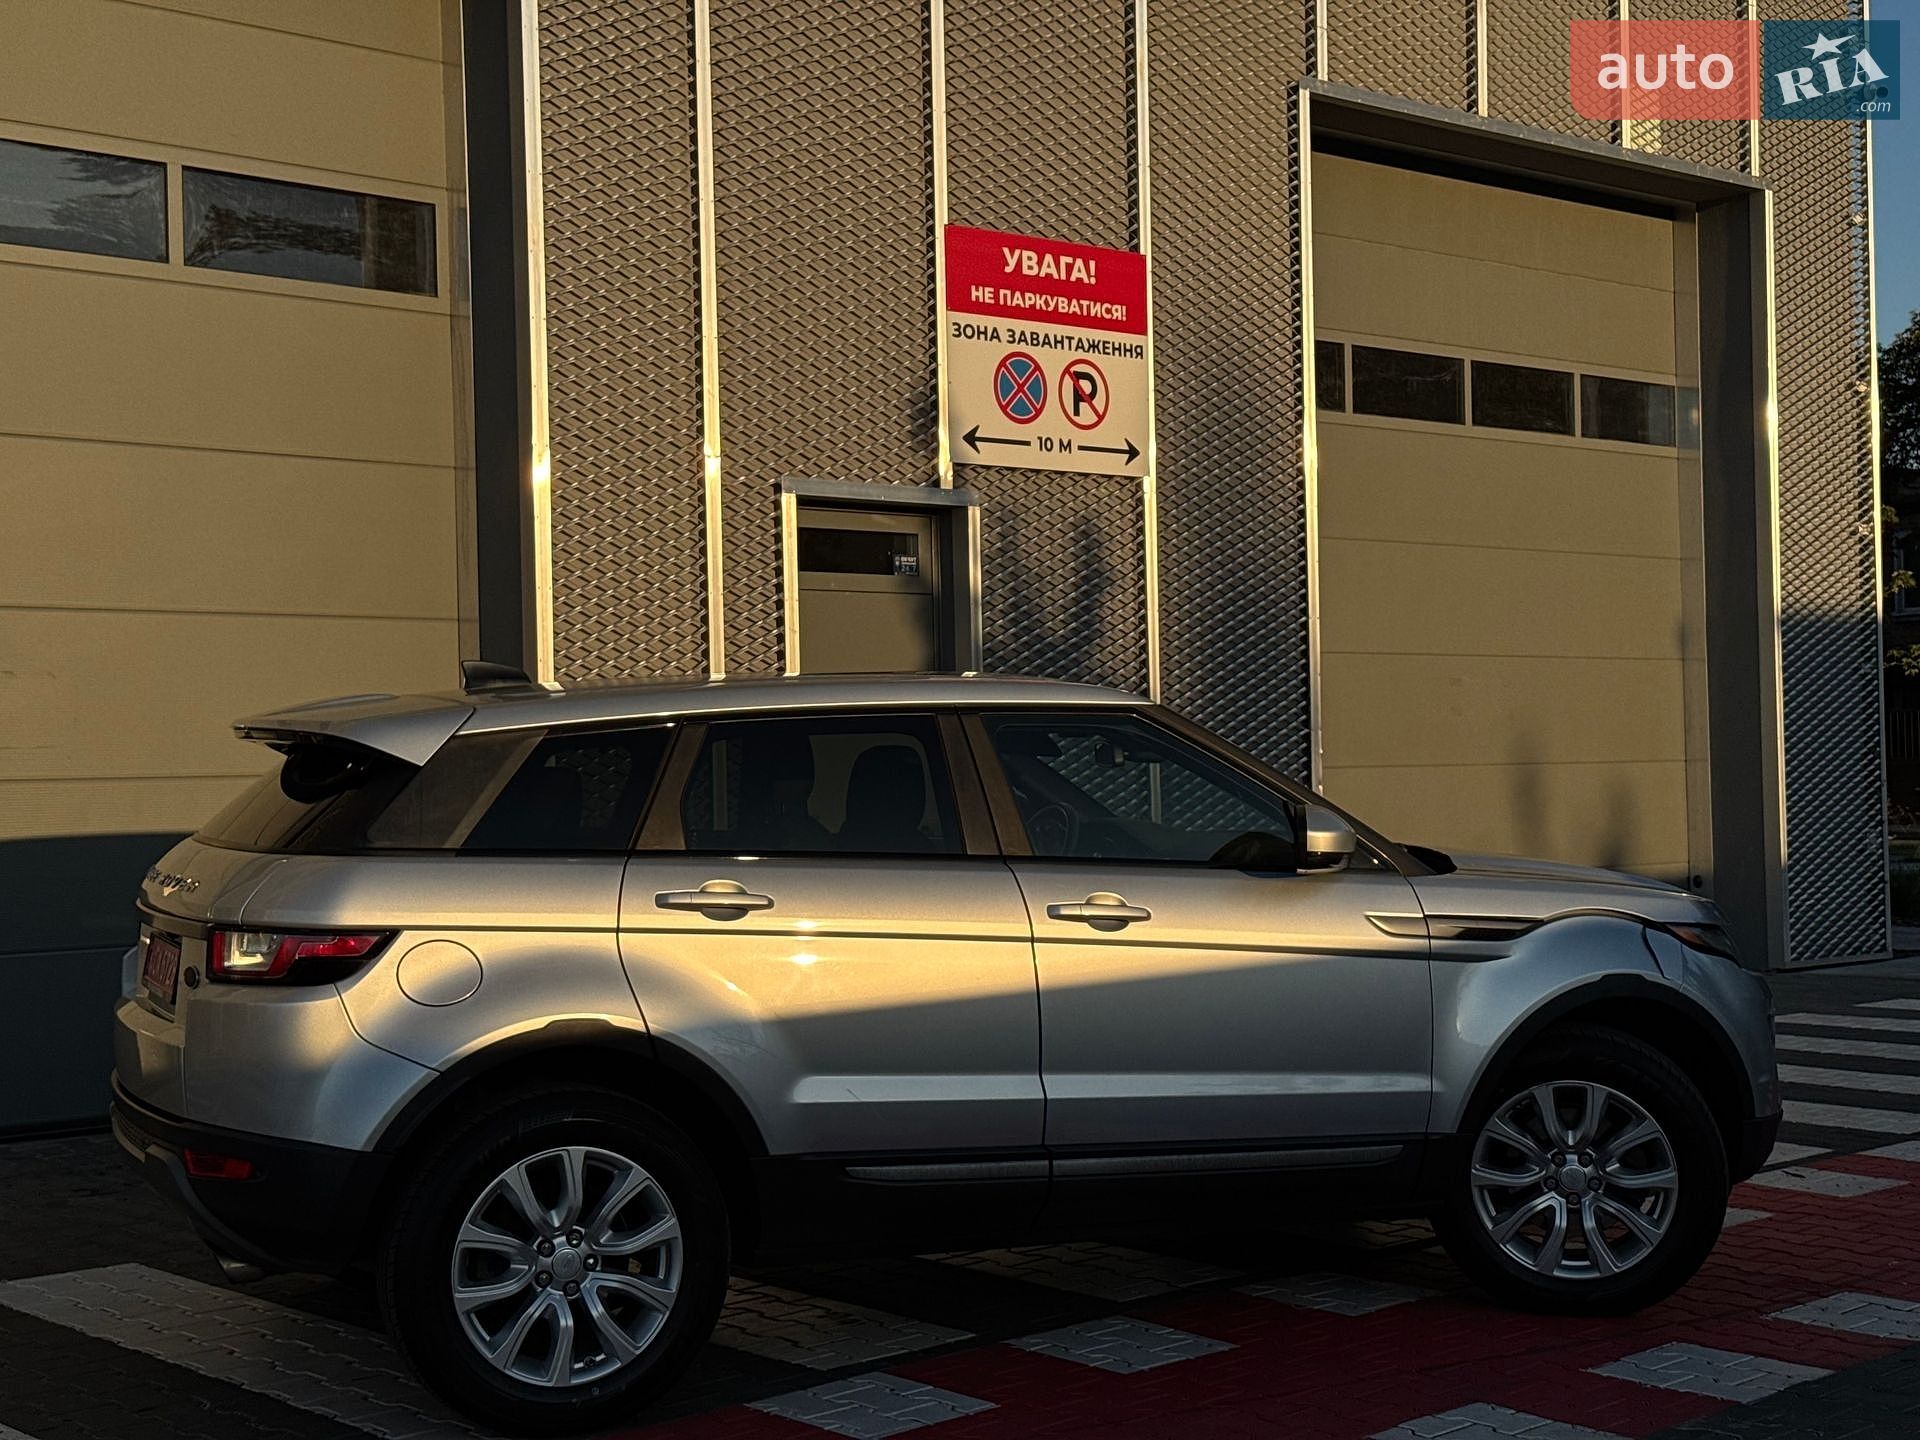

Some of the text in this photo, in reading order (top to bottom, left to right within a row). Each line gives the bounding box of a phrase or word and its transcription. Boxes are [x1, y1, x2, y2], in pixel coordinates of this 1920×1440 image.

[1002, 246, 1096, 285] УВАГА!
[970, 285, 1127, 322] НЕ ПАРКУВАТИСЯ!
[951, 321, 1144, 360] ЗОНА ЗАВАНТАЖЕННЯ
[1036, 435, 1054, 452] 10
